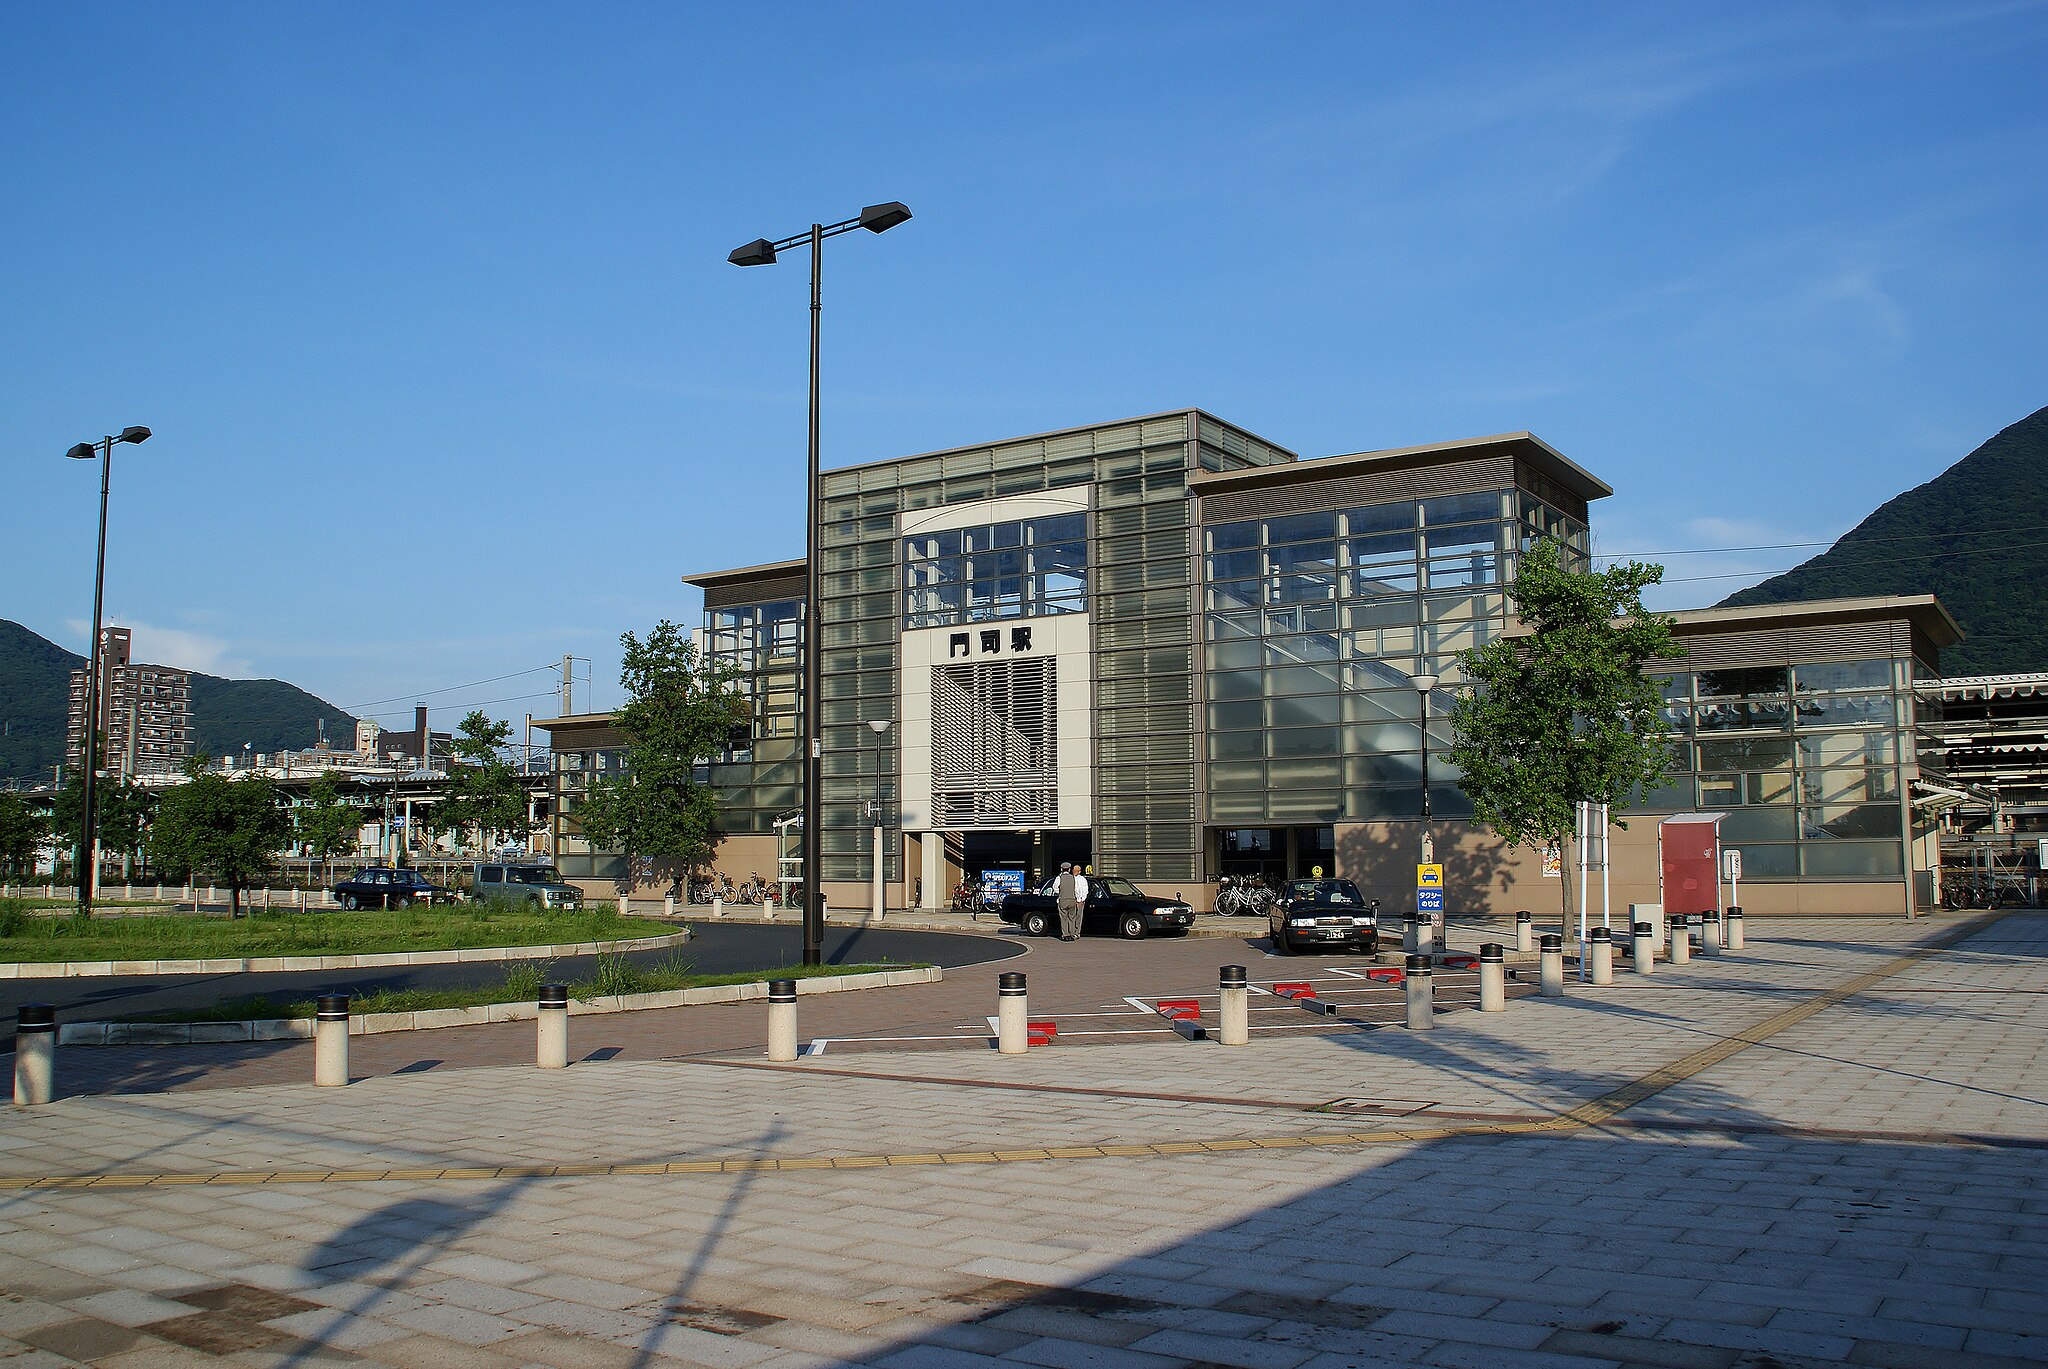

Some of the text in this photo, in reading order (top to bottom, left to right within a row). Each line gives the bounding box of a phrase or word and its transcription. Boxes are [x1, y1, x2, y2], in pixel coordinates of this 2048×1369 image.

[950, 627, 1032, 658] 門司駅
[1421, 900, 1440, 908] のりば
